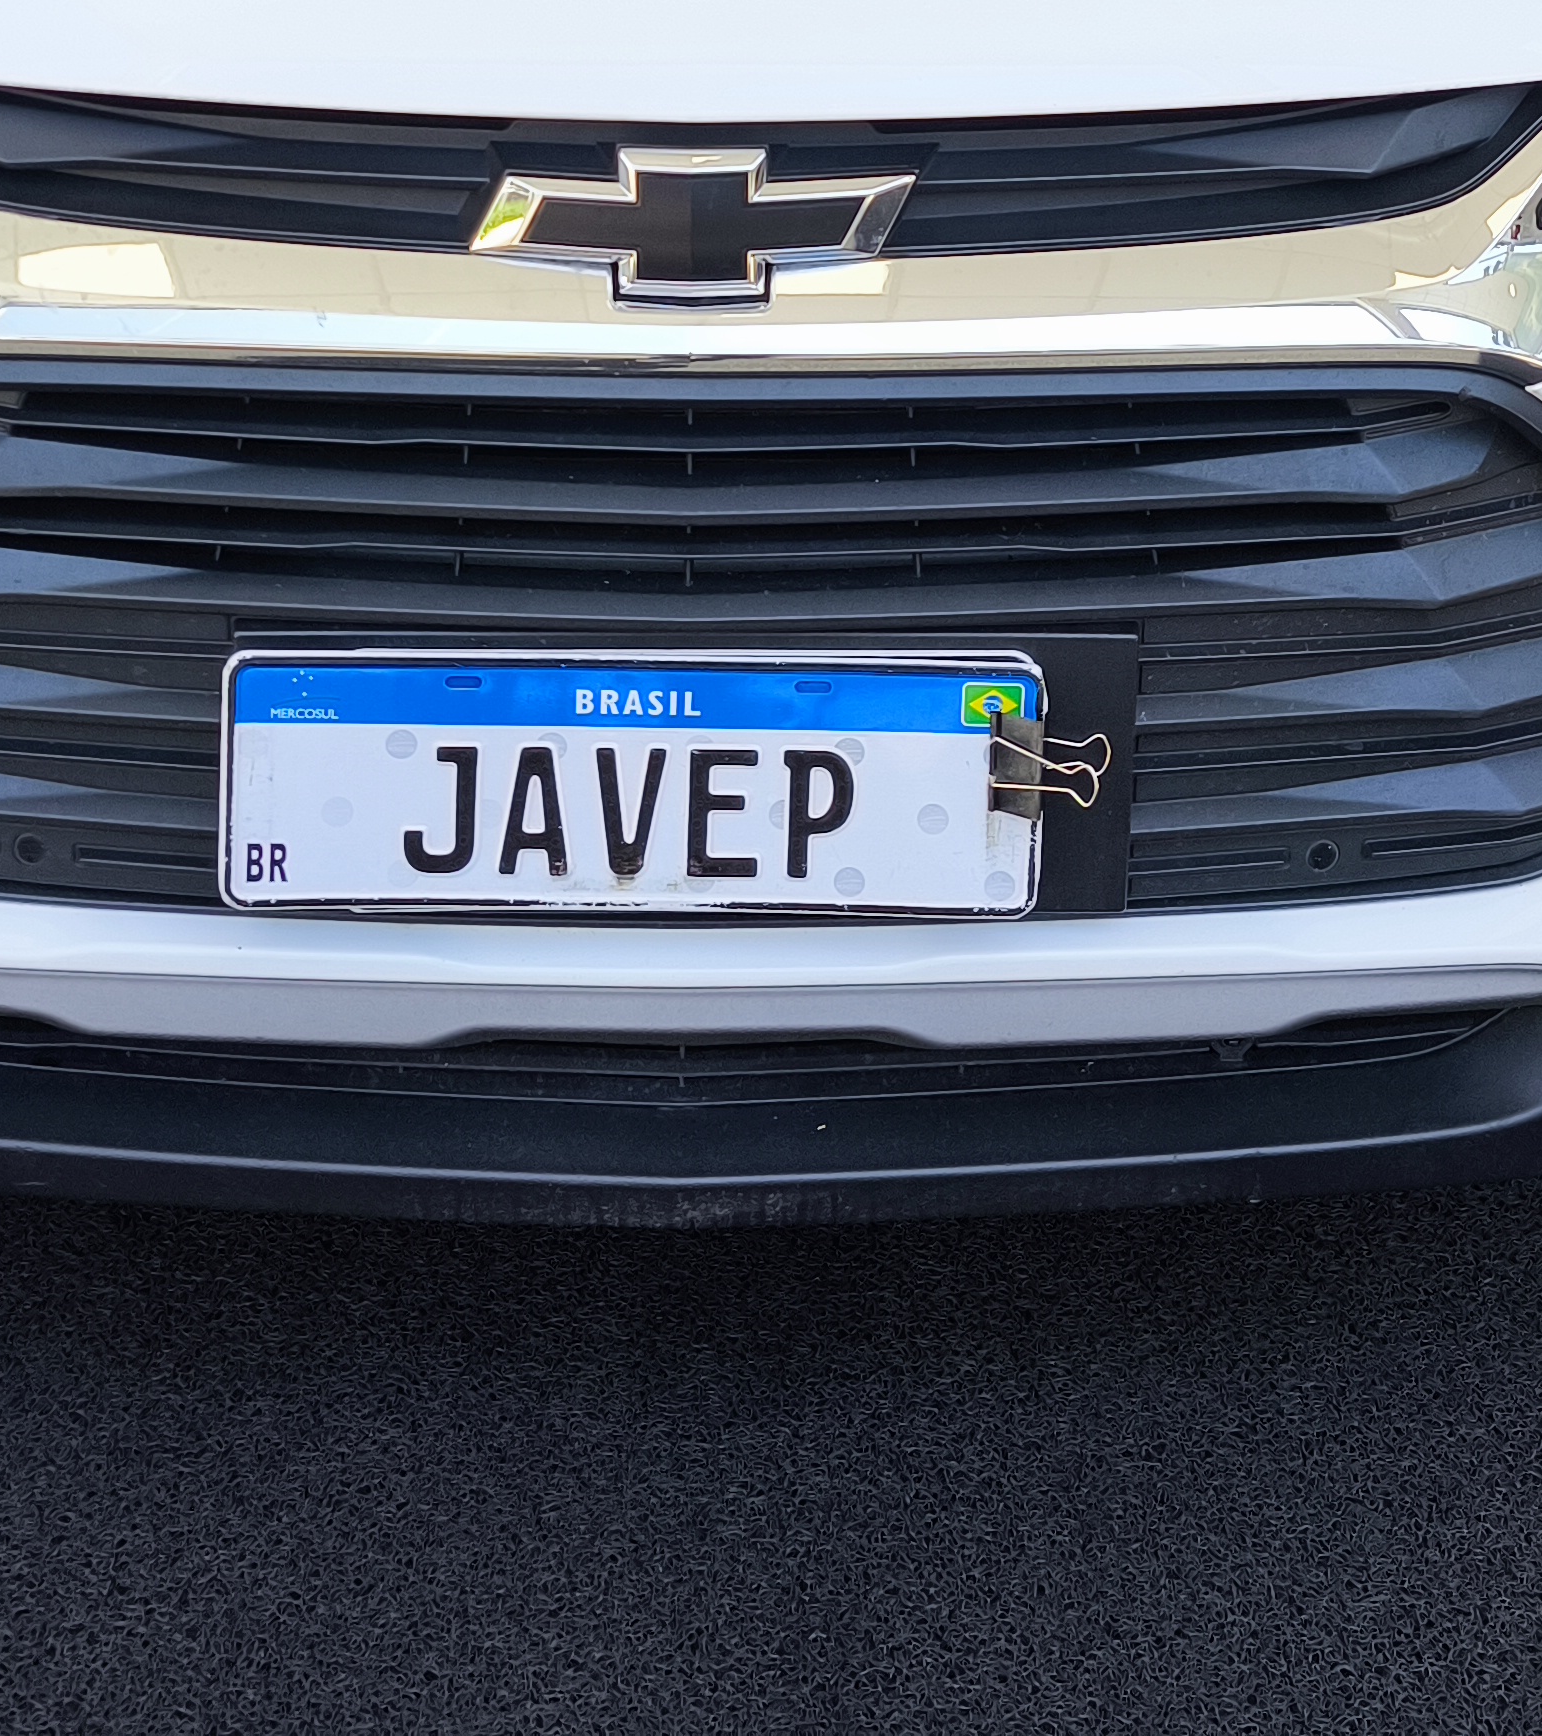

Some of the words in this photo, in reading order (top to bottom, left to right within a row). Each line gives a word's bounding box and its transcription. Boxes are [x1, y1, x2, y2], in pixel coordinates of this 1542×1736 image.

[270, 707, 339, 720] MERCOSUL
[575, 688, 702, 717] BRASIL
[403, 745, 856, 879] JAVEP
[245, 842, 289, 884] BR
